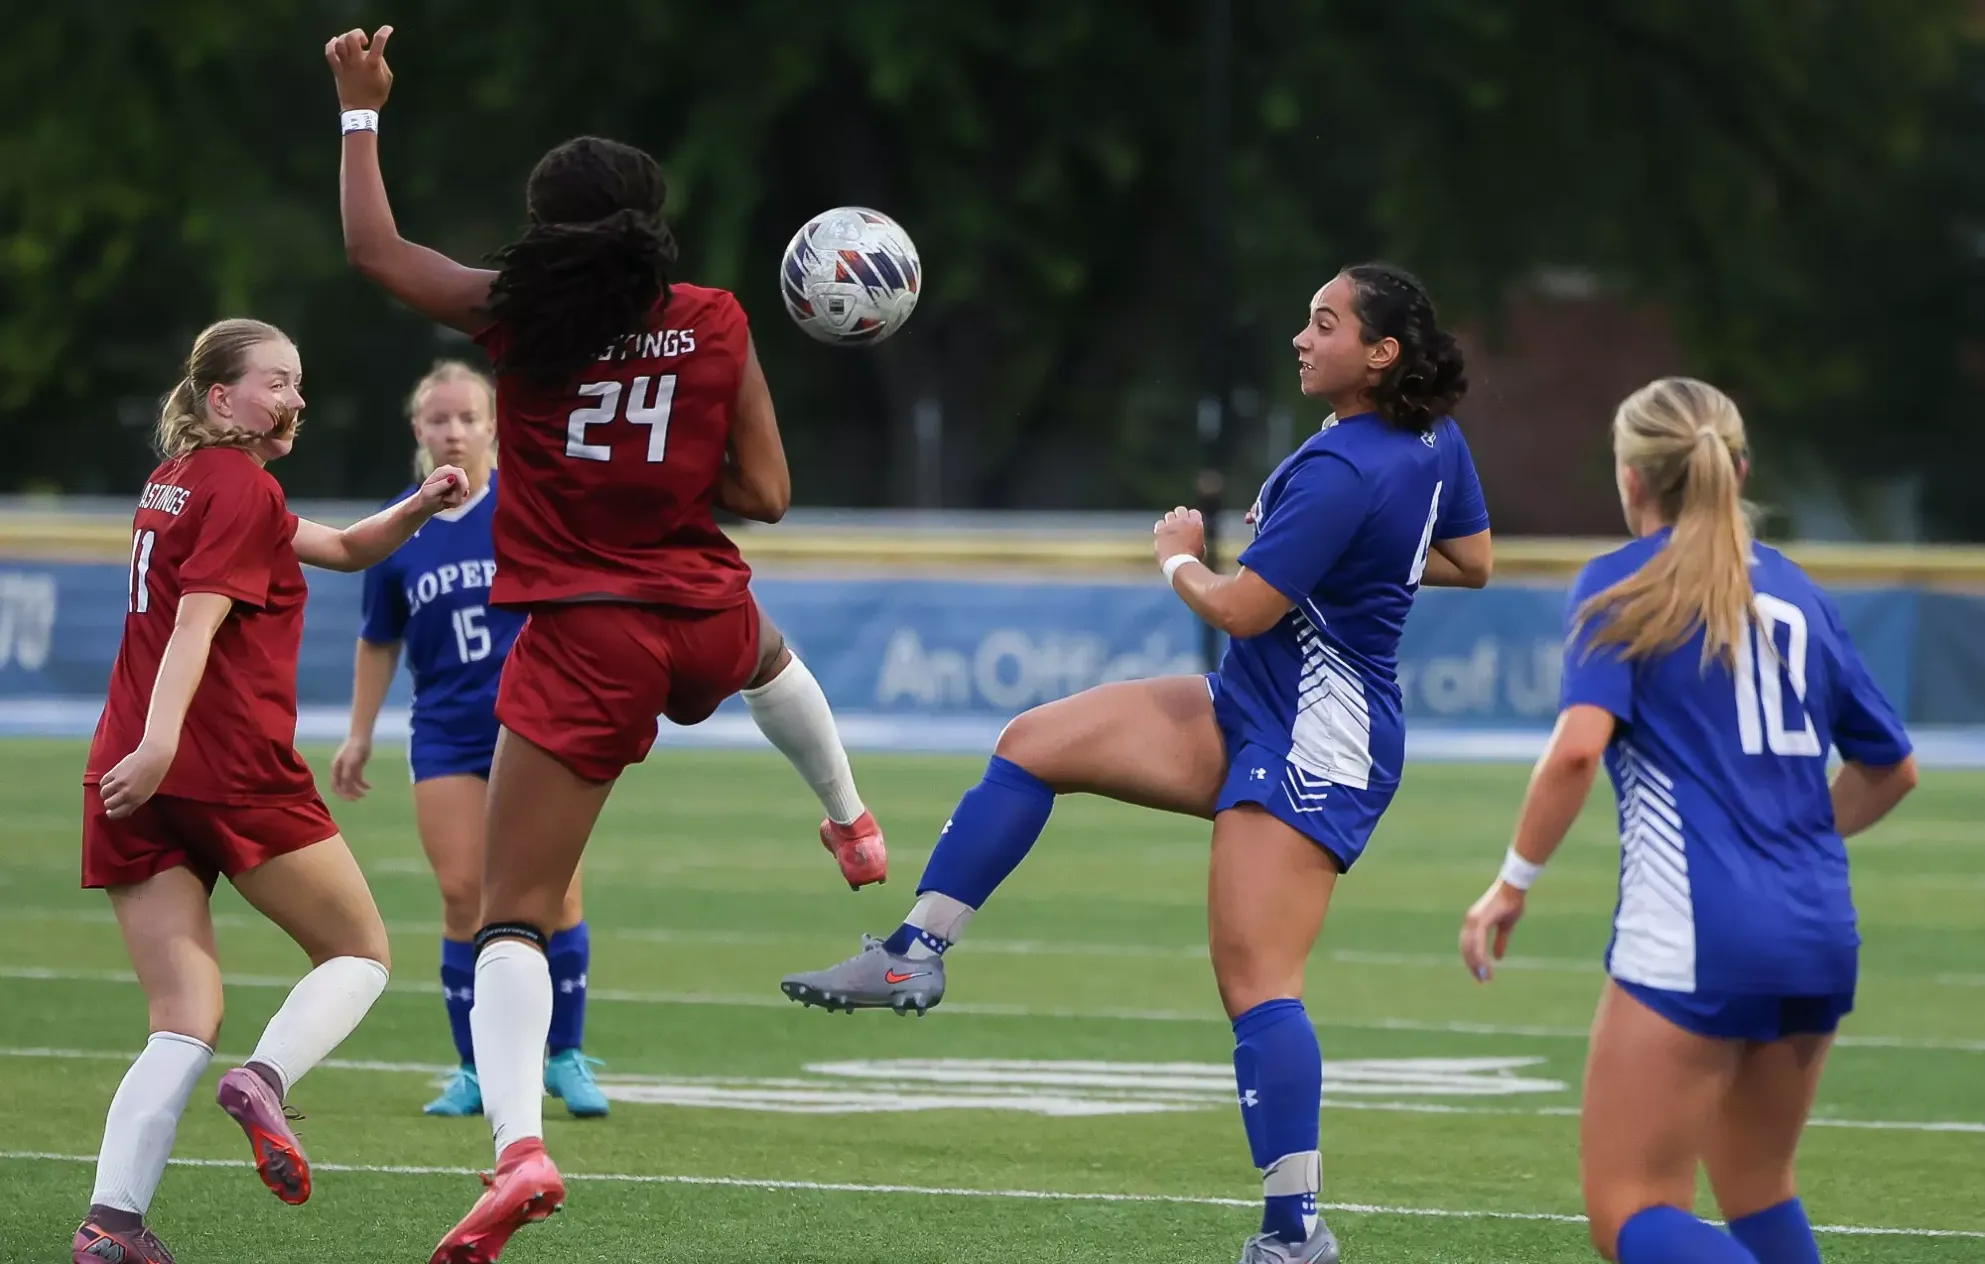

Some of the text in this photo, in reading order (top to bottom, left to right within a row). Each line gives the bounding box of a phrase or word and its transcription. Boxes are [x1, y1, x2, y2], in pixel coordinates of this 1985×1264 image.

[565, 374, 677, 462] 24
[138, 481, 191, 516] ASTINGS
[452, 604, 492, 664] 15
[876, 625, 970, 704] An
[1734, 591, 1823, 757] 10
